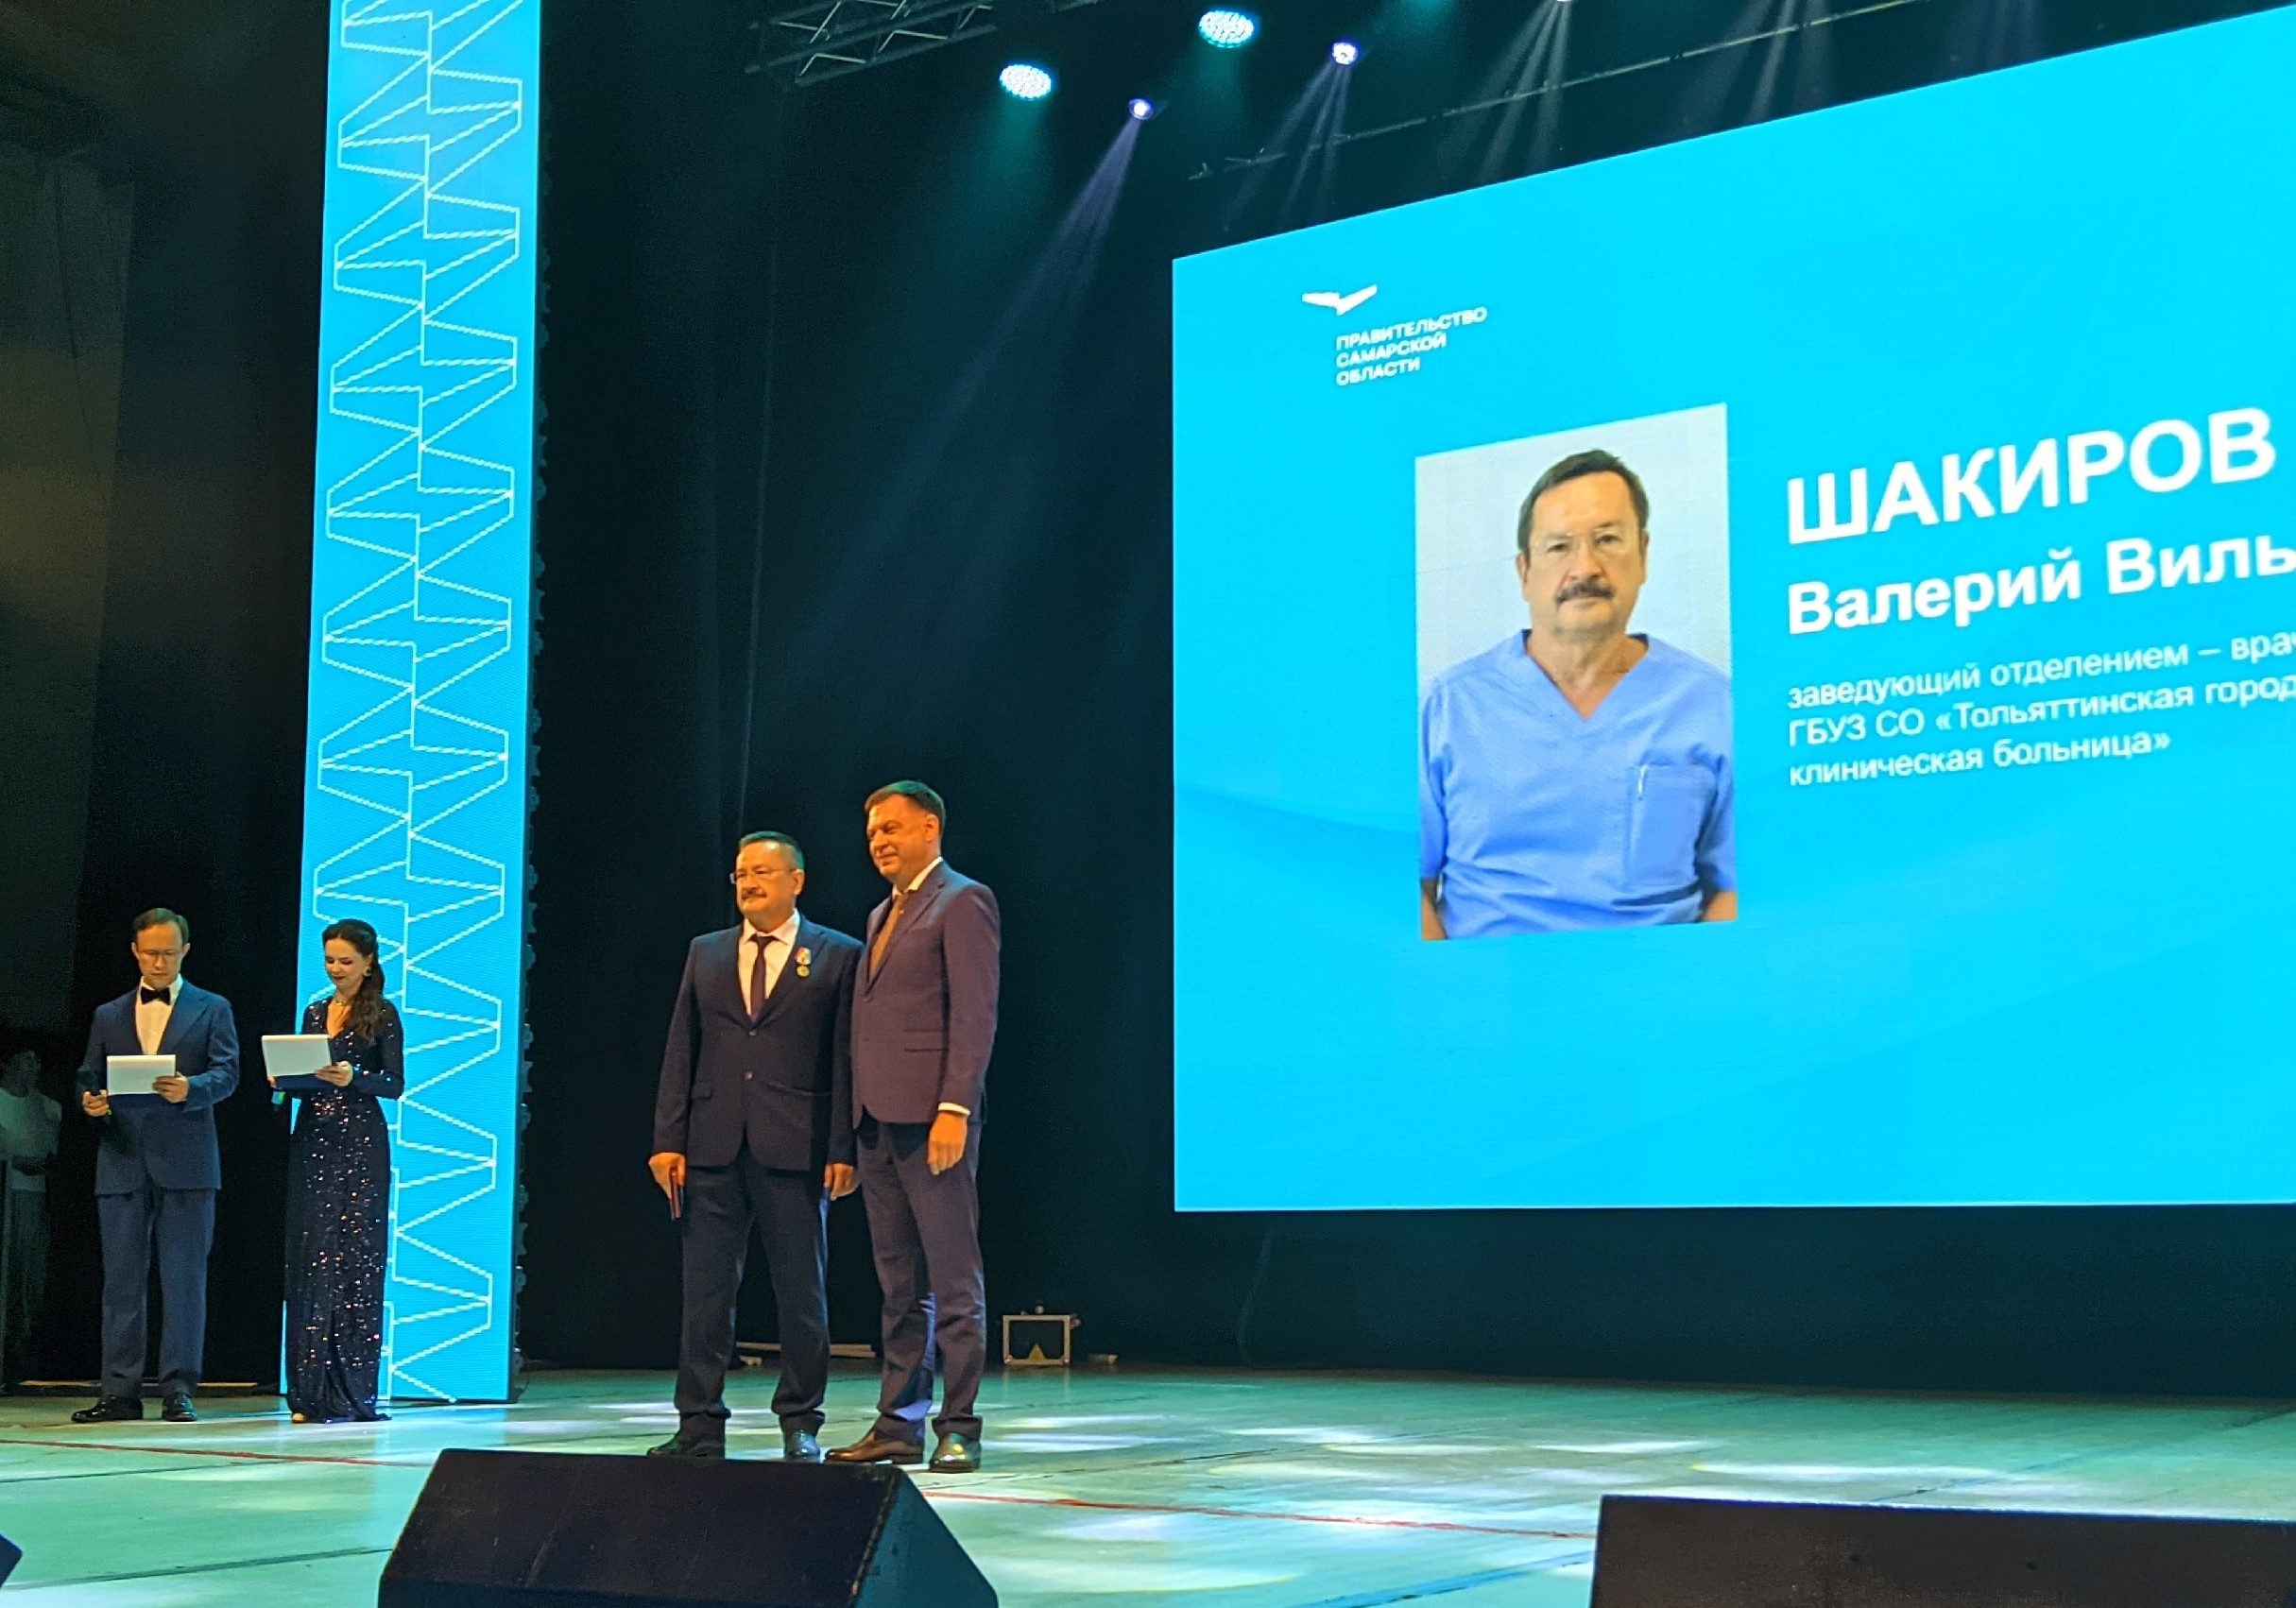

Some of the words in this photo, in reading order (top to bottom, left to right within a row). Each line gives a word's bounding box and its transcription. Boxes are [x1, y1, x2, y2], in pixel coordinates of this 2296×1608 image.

[1336, 307, 1487, 351] ПРАВИТЕЛЬСТВО
[1336, 332, 1447, 368] САМАРСКОЙ
[1336, 357, 1420, 386] ОБЛАСТИ
[1788, 407, 2275, 544] ШАКИРОВ
[1789, 547, 2081, 635] Валерий
[2107, 535, 2296, 594] Виль
[1788, 662, 1980, 709] заведующий
[1990, 643, 2189, 688] отделением
[1789, 714, 1866, 746] ГБУЗ
[1876, 709, 1925, 738] СО
[1936, 686, 2194, 731] «Тольяттинская
[1790, 748, 1983, 786] клиническая
[1994, 730, 2170, 767] больница»
